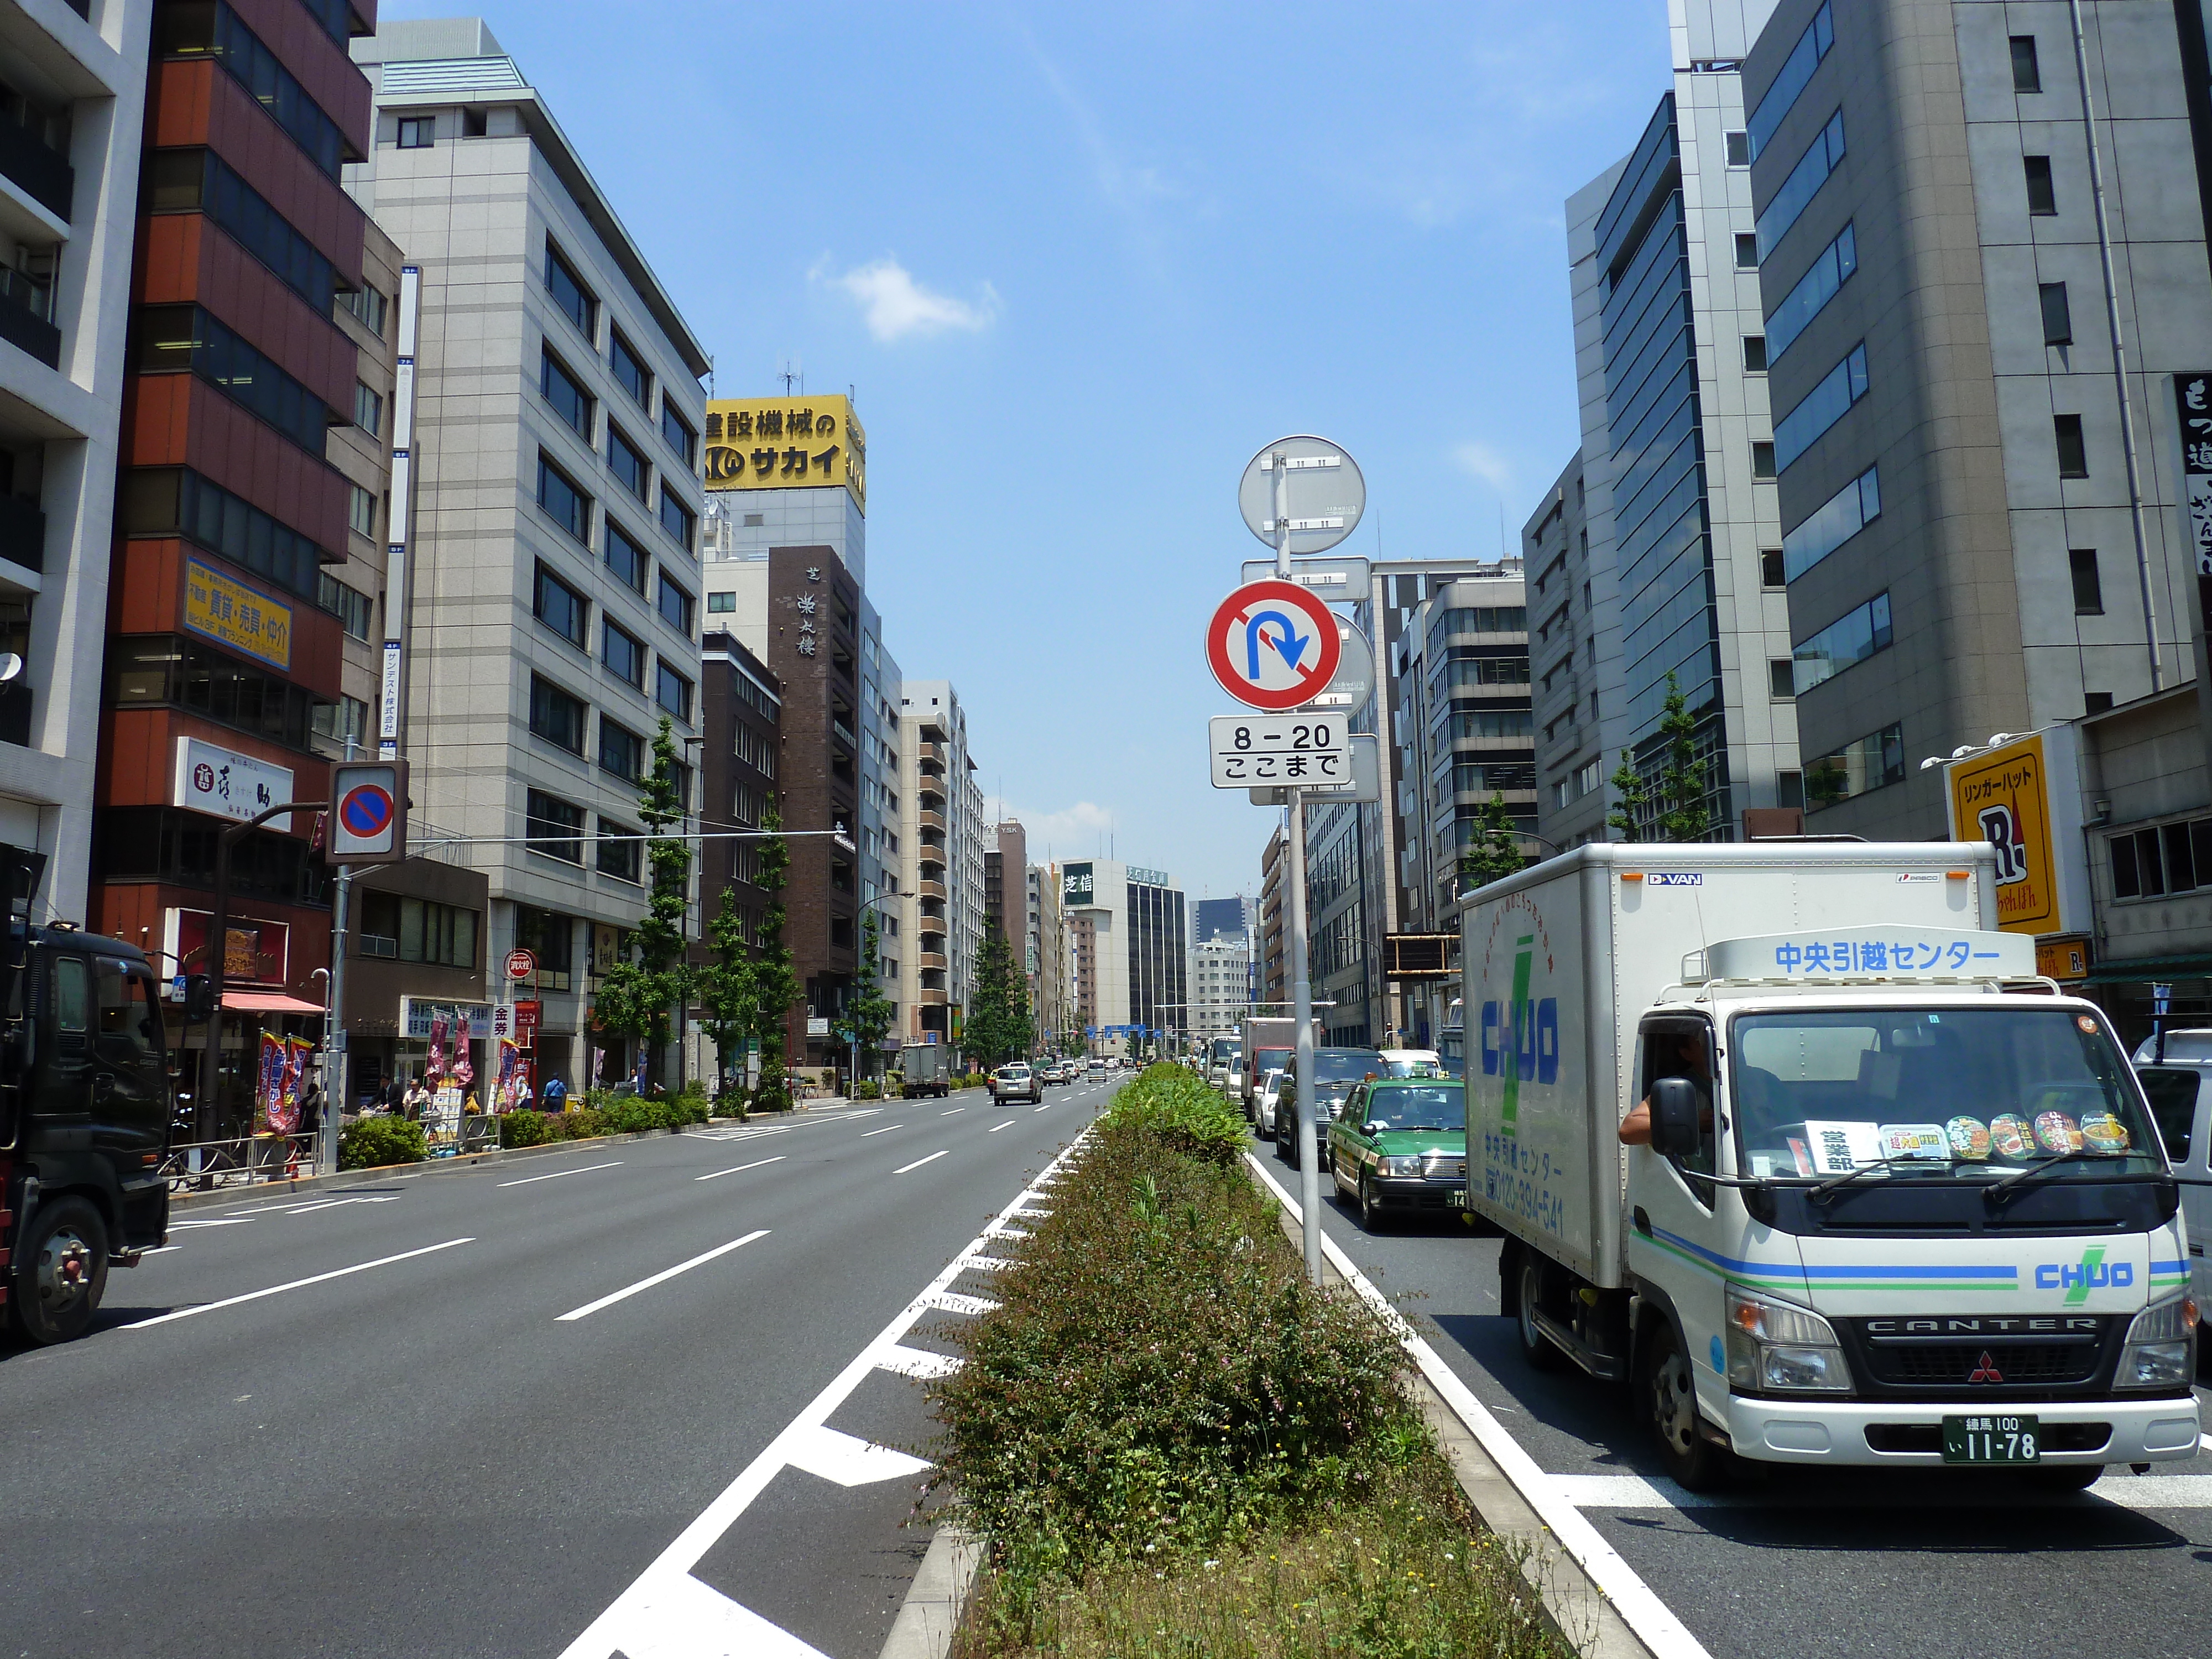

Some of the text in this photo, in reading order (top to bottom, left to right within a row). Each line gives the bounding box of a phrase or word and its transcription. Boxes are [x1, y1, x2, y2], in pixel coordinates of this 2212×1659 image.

[750, 445, 840, 474] サカイ
[806, 567, 821, 581] 芝
[384, 653, 397, 733] サンテスト株式会社
[1225, 755, 1339, 779] ここまで
[1964, 766, 2032, 804] リンガーハット
[1065, 873, 1093, 893] 芝信
[510, 959, 530, 970] 消火栓
[1776, 941, 2000, 973] 中央引越センター
[494, 1008, 508, 1035] 金券
[1481, 998, 1559, 1086] CHUO
[1485, 1128, 1562, 1181] 中央引越センター
[1820, 1131, 1855, 1171] 営業部
[1496, 1168, 1563, 1239] 0120-394-541
[2035, 1262, 2133, 1289] CHUO
[1867, 1318, 2097, 1331] CANTER
[1966, 1417, 2018, 1431] 練馬 100
[1948, 1433, 2035, 1459] い 11-78
